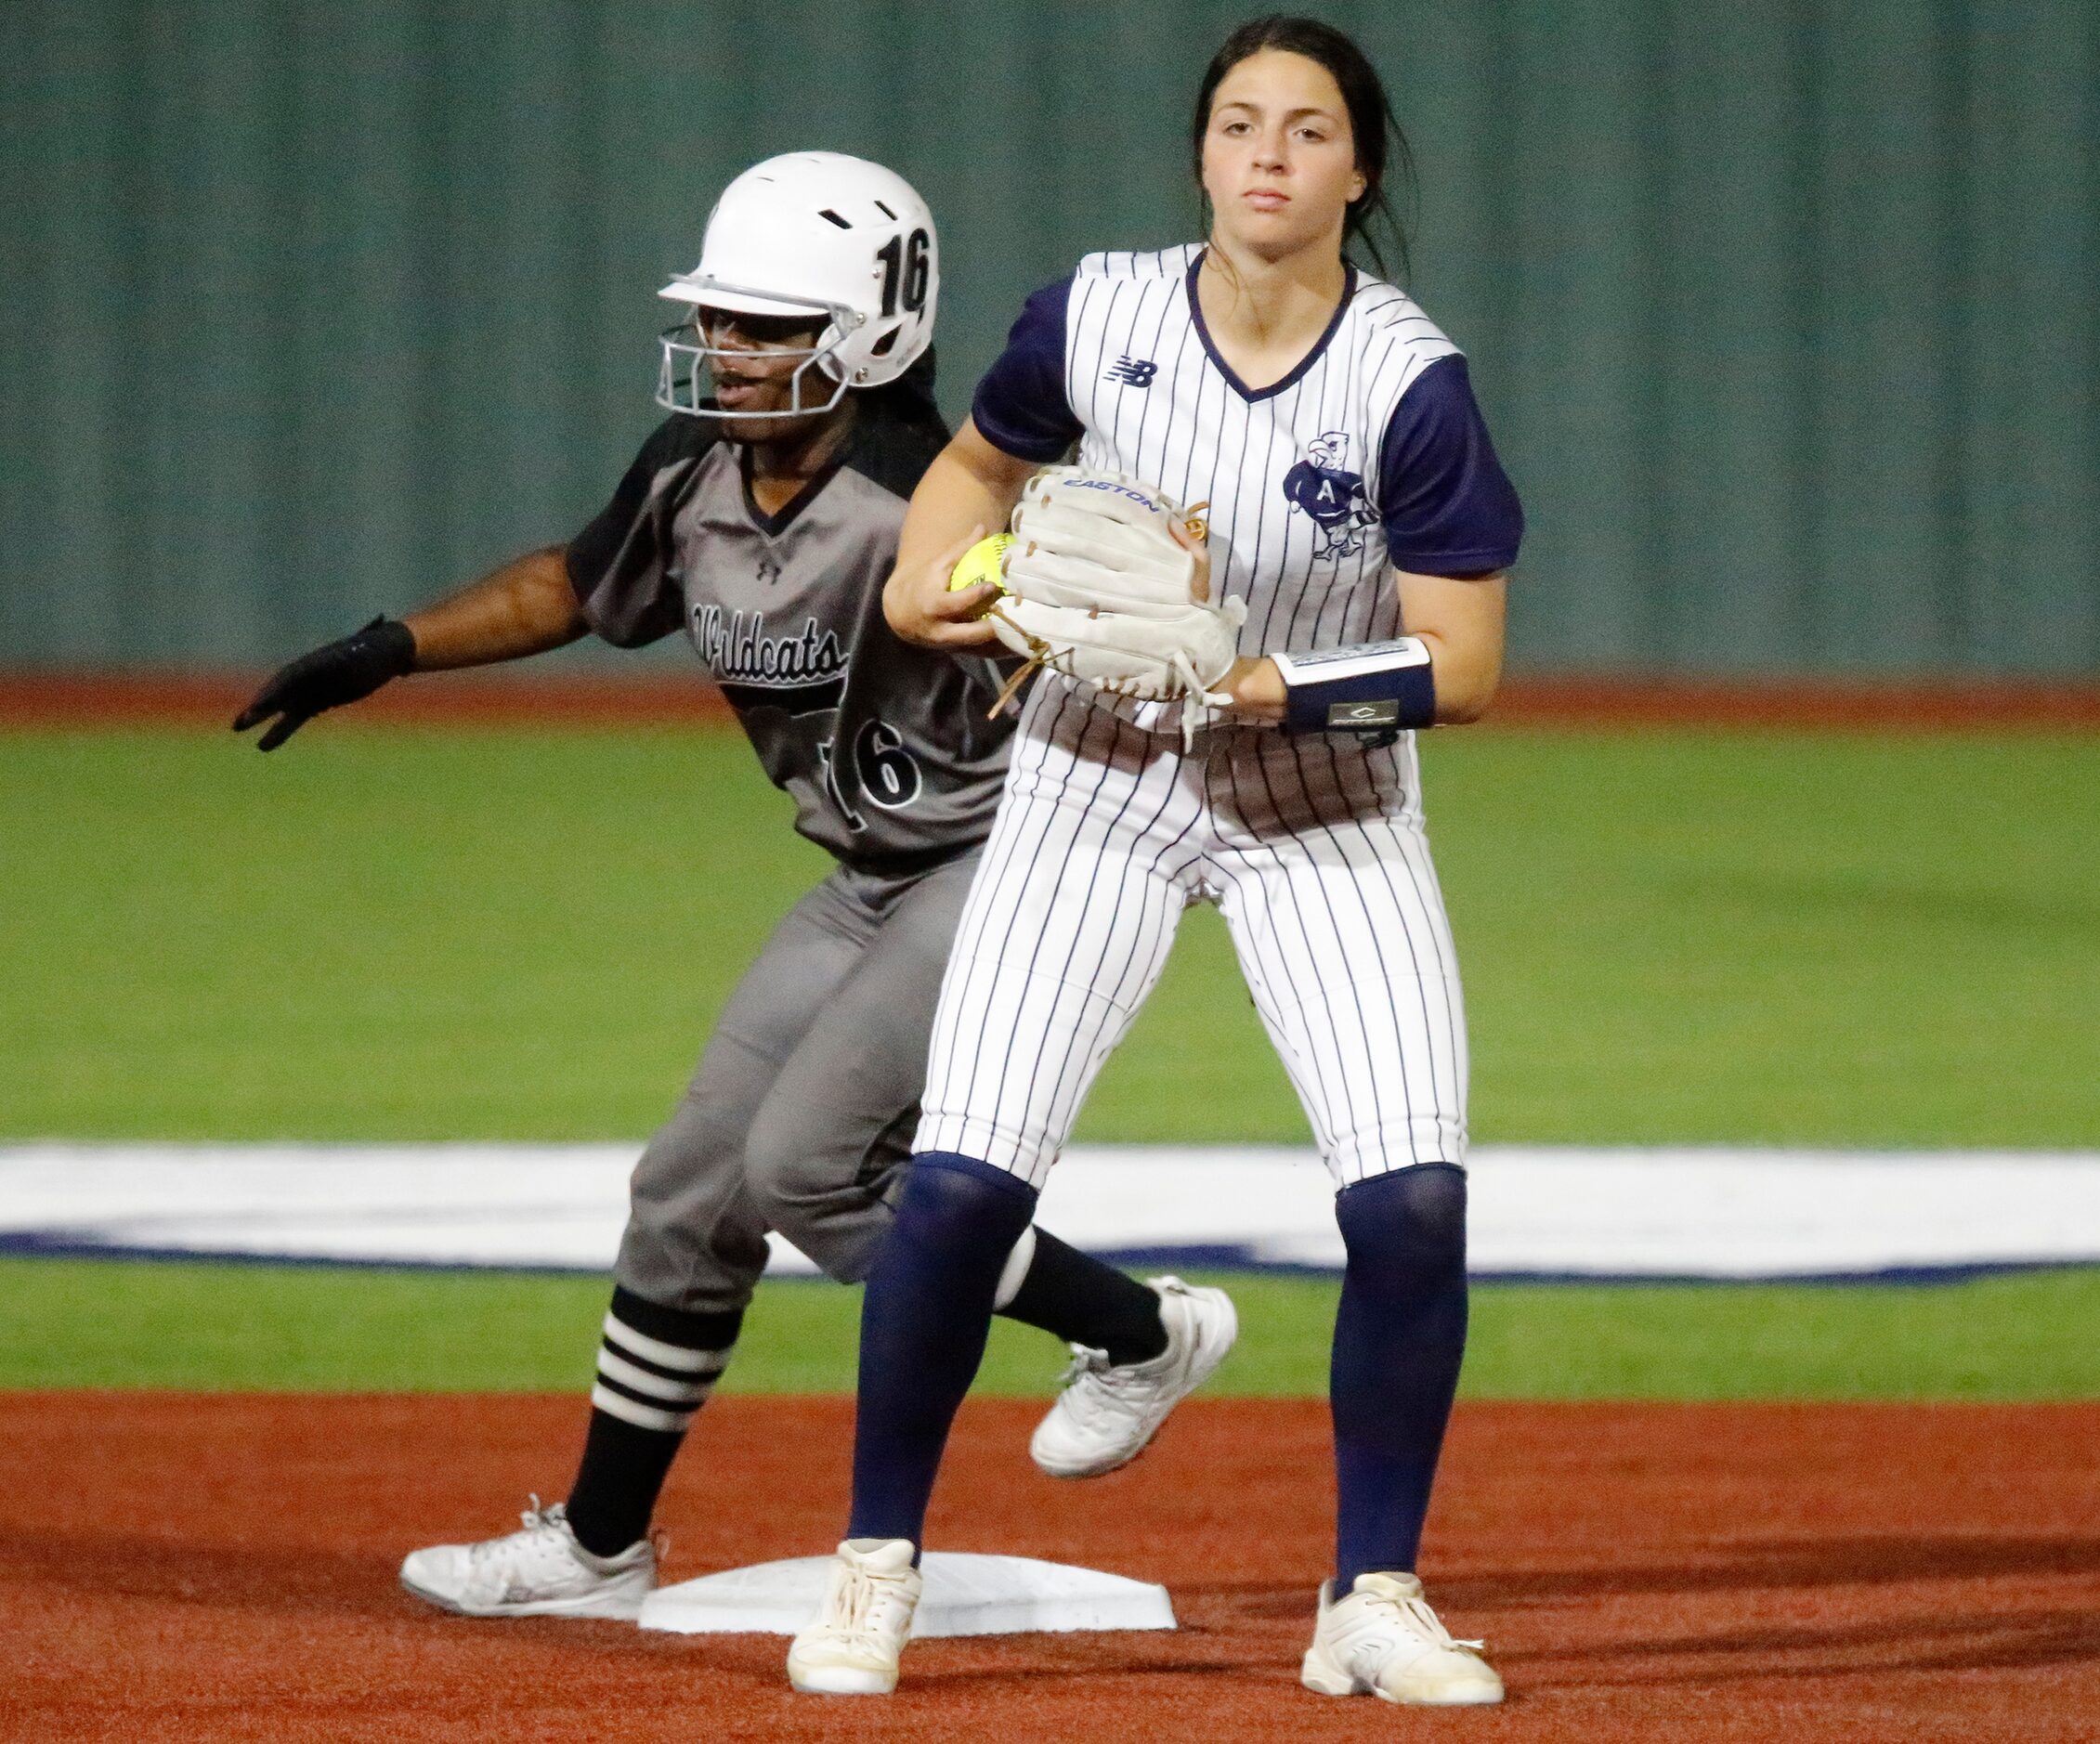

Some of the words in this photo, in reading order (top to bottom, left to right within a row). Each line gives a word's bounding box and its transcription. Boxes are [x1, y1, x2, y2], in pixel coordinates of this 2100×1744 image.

[877, 228, 930, 318] 16
[1063, 479, 1160, 513] EASTON
[1316, 479, 1336, 504] A
[694, 603, 851, 683] Wildcats
